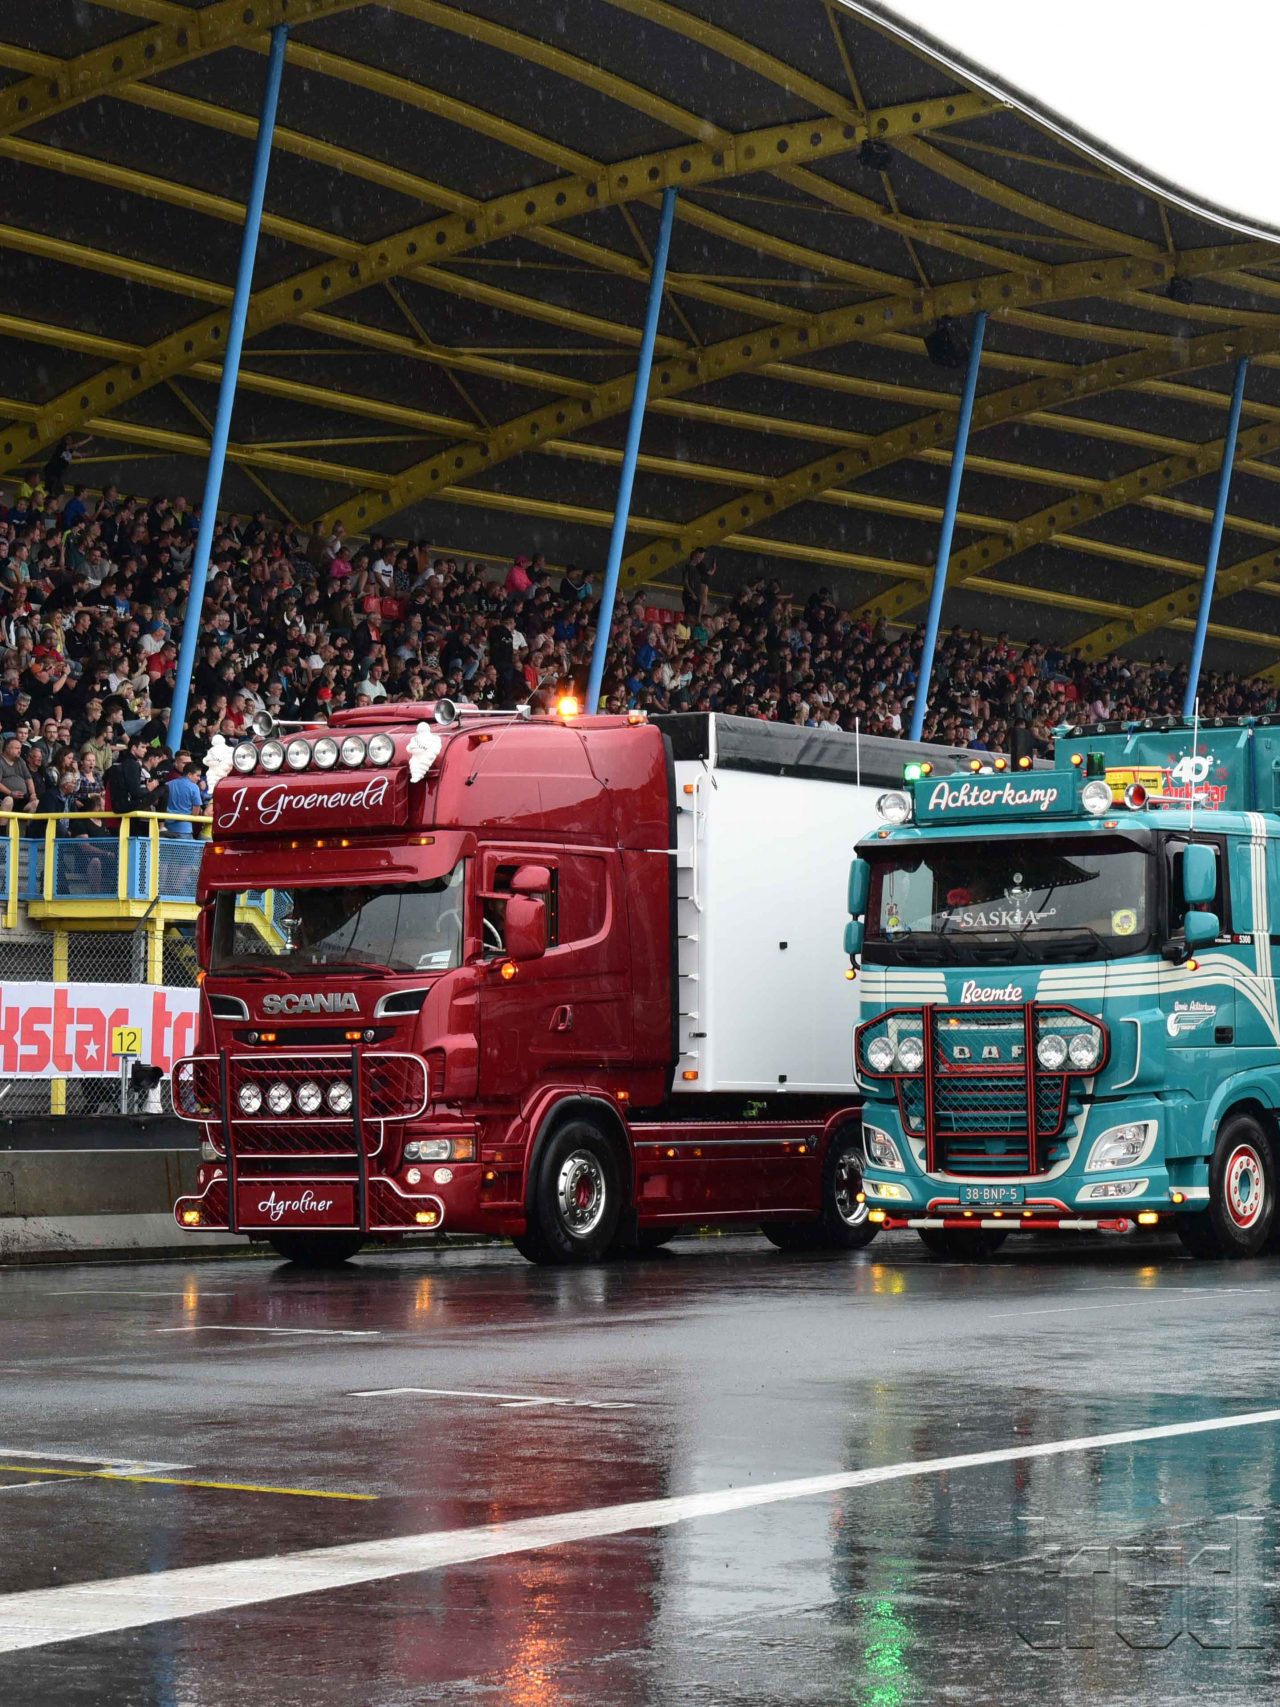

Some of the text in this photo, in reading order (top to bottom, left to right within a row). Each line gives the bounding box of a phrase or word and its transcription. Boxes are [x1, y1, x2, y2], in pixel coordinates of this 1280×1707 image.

[217, 775, 389, 829] J. Groeneveld
[928, 781, 1057, 811] Achterkamp
[962, 911, 1039, 928] SASKIA
[960, 979, 1023, 1004] Beemte
[262, 992, 360, 1015] SCANIA
[117, 1031, 137, 1052] 12
[952, 1045, 1025, 1059] DAF
[258, 1189, 333, 1222] Agroliner
[965, 1188, 1017, 1200] 38-BNP-5
